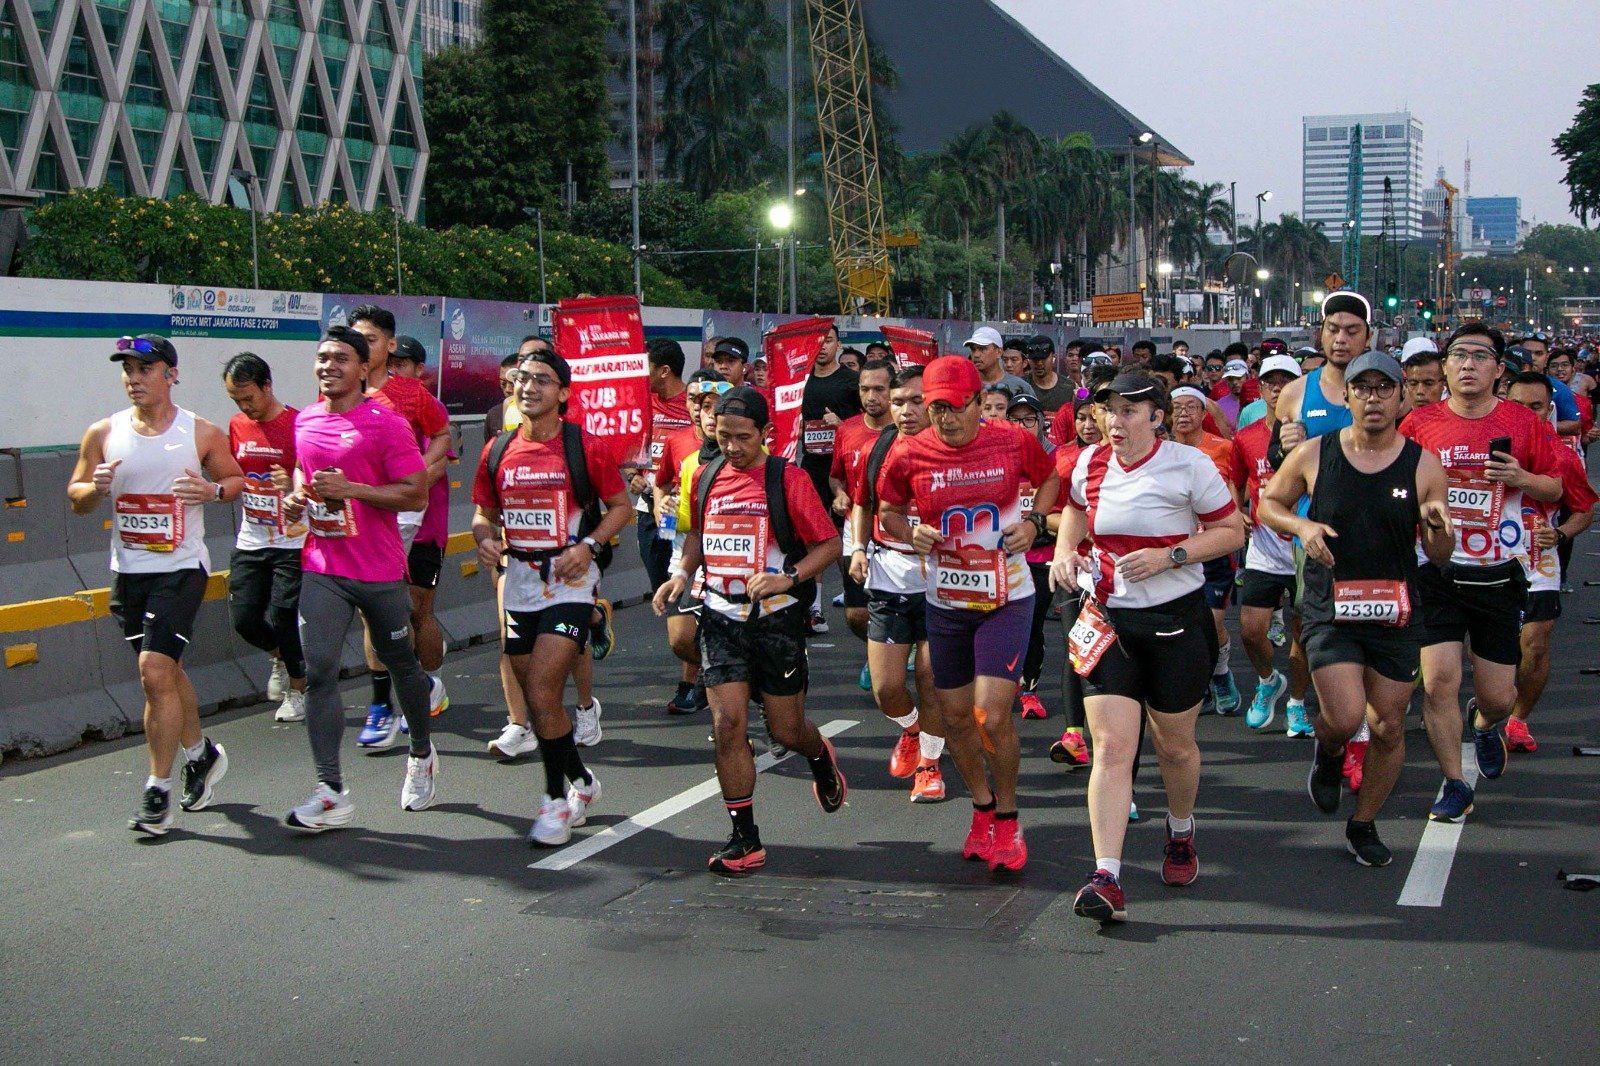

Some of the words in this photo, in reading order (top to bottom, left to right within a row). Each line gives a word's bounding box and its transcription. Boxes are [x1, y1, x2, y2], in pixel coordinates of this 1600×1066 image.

[171, 316, 198, 327] PROYEK
[199, 317, 212, 327] MRT
[212, 317, 240, 328] JAKARTA
[240, 318, 256, 329] FASE
[257, 319, 261, 329] 2
[448, 344, 466, 354] ASEAN
[593, 359, 643, 374] MARATHON
[580, 387, 616, 409] SUB
[806, 431, 834, 441] 22022
[1453, 452, 1490, 461] JAKARTA
[515, 472, 548, 481] JAKARTA
[549, 472, 566, 480] RUN
[986, 467, 1005, 477] RUN
[558, 491, 566, 531] MARATHON
[751, 502, 768, 510] RUN
[121, 515, 169, 529] 20534
[507, 511, 552, 526] PACER
[1491, 513, 1500, 529] HALF
[706, 537, 751, 552] PACER
[757, 517, 767, 558] MARATHON
[940, 570, 989, 588] 20291
[997, 551, 1006, 593] MARATHON
[1340, 603, 1394, 617] 25307
[568, 624, 579, 637] T8
[1081, 655, 1097, 674] HALF
[1093, 629, 1117, 659] MARATH
